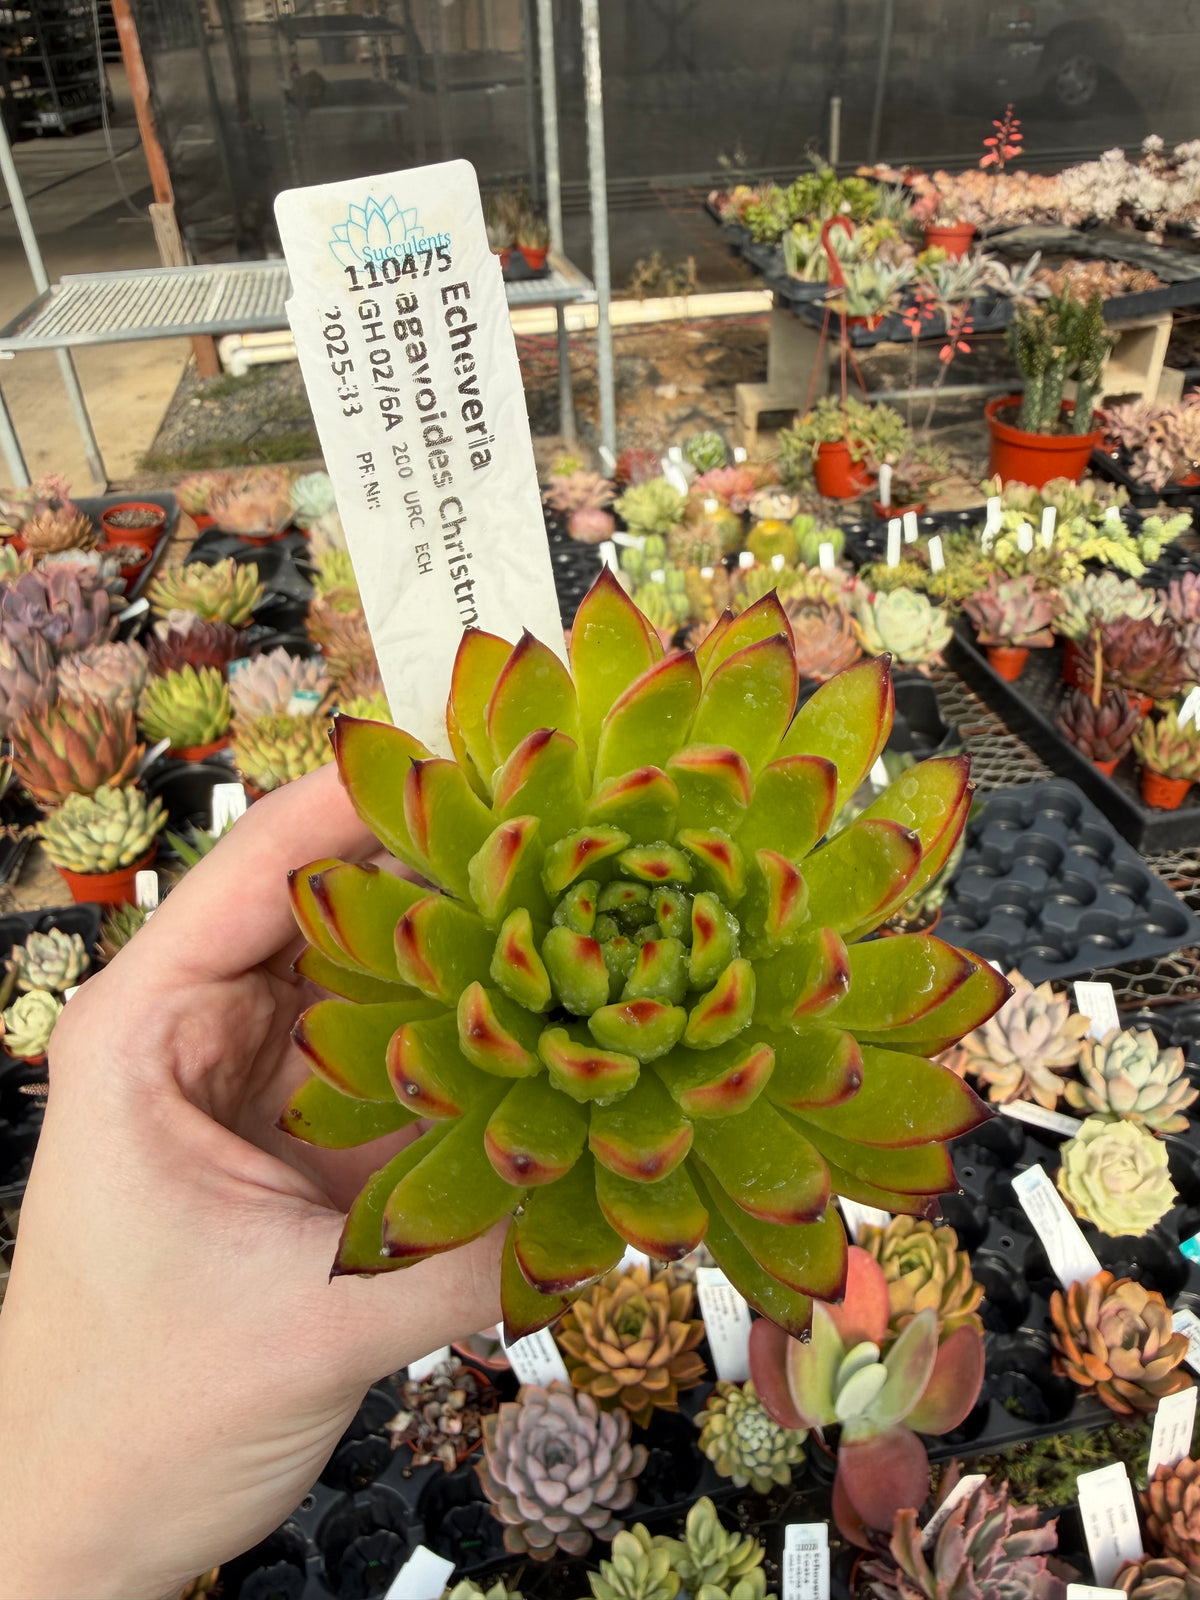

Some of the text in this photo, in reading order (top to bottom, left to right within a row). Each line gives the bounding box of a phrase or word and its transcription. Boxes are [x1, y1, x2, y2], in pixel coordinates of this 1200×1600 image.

[344, 244, 452, 292] 110475
[362, 232, 451, 263] Succulents
[321, 306, 363, 417] 2025-33
[440, 281, 495, 471] Echeveria
[358, 299, 433, 575] GH 02/6A 200 URC ECH
[393, 291, 453, 488] agavoides
[439, 496, 481, 629] Christm
